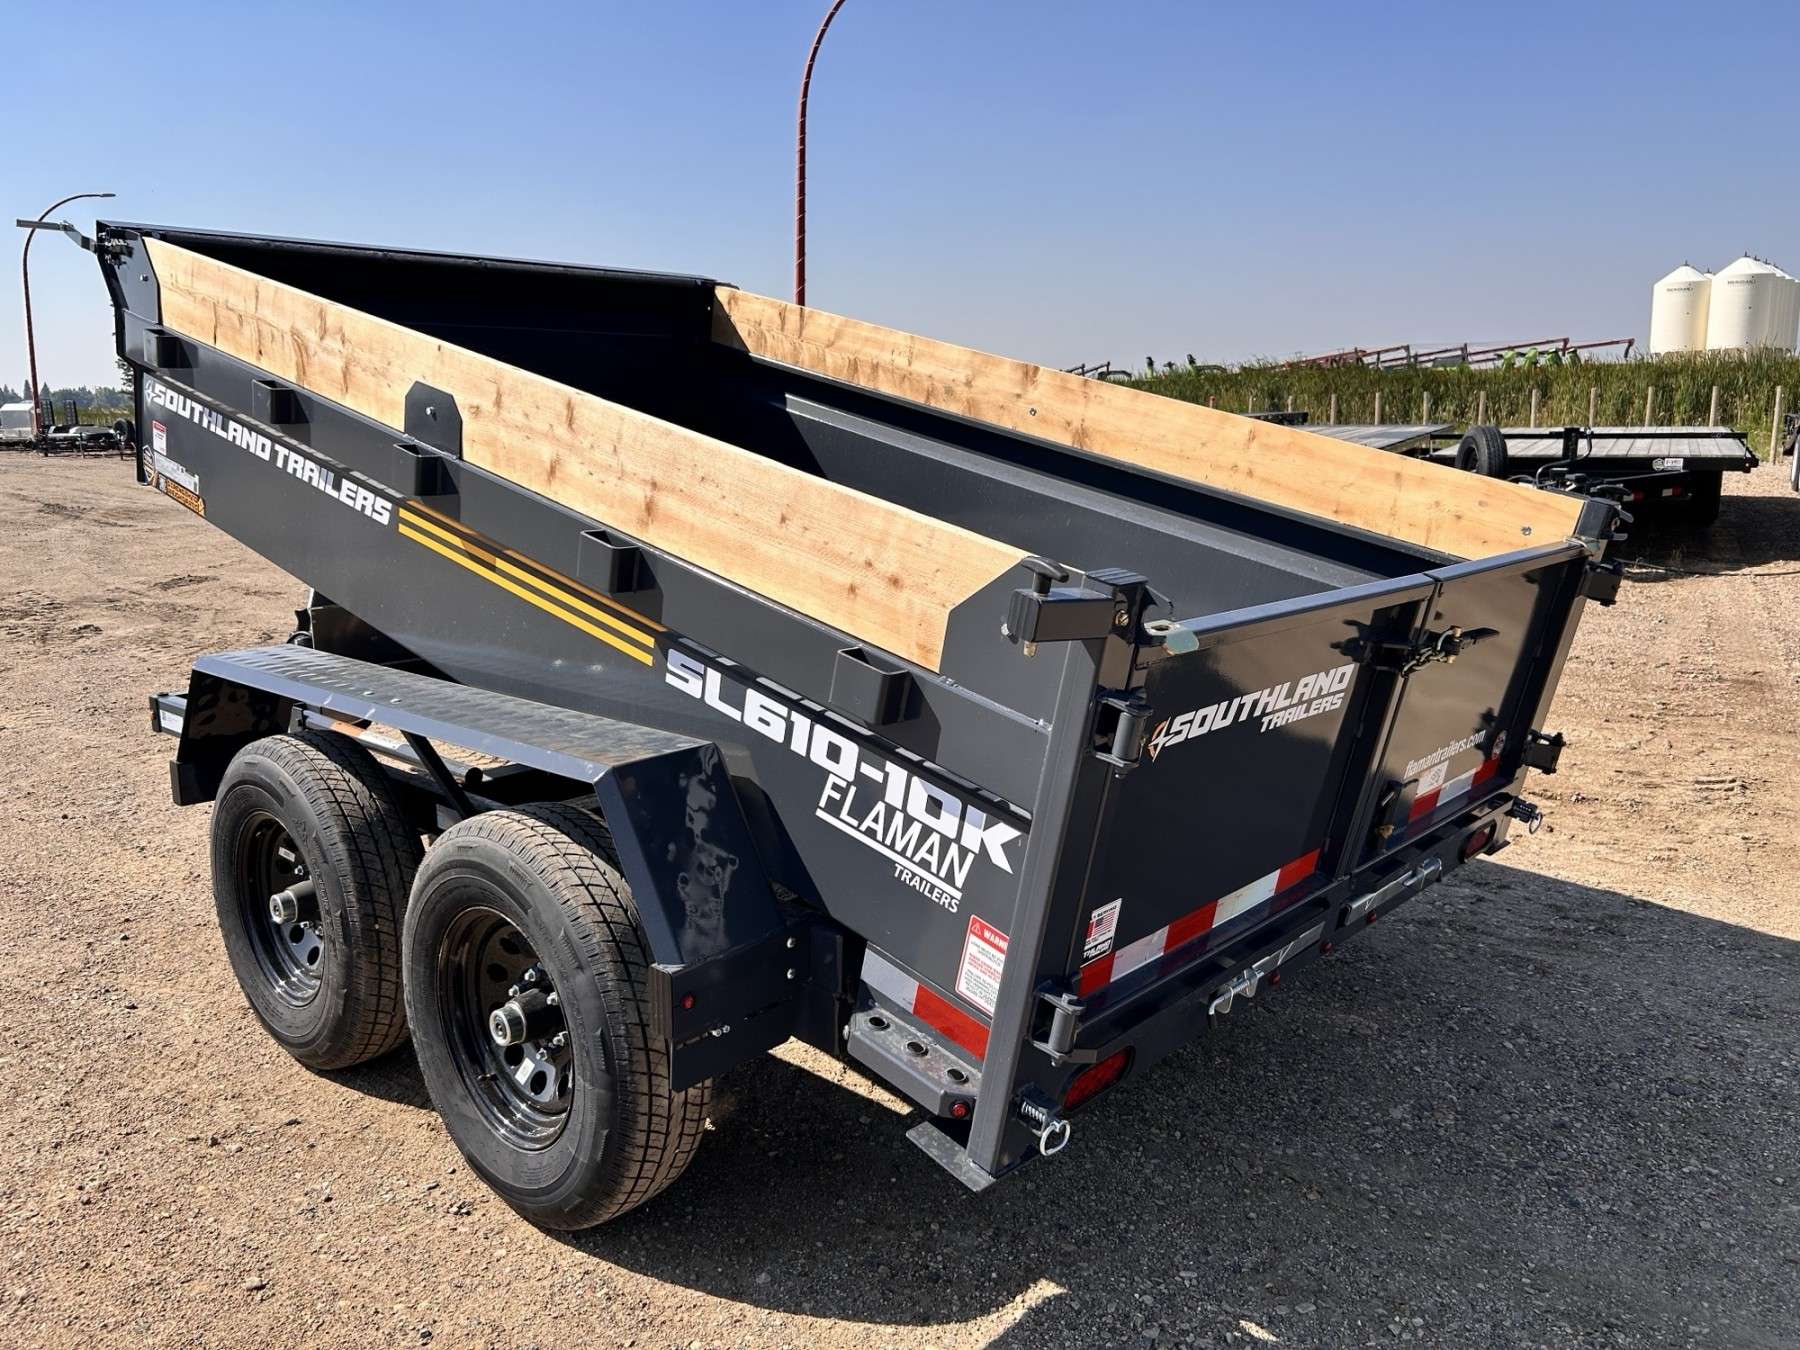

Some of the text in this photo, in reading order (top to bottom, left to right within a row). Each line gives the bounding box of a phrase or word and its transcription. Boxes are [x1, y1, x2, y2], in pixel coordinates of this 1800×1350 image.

[152, 383, 272, 462] SOUTHLAND
[274, 443, 393, 526] TRAILERS
[1165, 663, 1355, 747] SOUTHLAND
[1260, 692, 1345, 733] TRAILERS
[665, 648, 1021, 874] SL610-10K
[1403, 729, 1487, 779] flamantrailers.com
[818, 773, 975, 889] FLAMAN
[894, 862, 960, 913] TRAILERS
